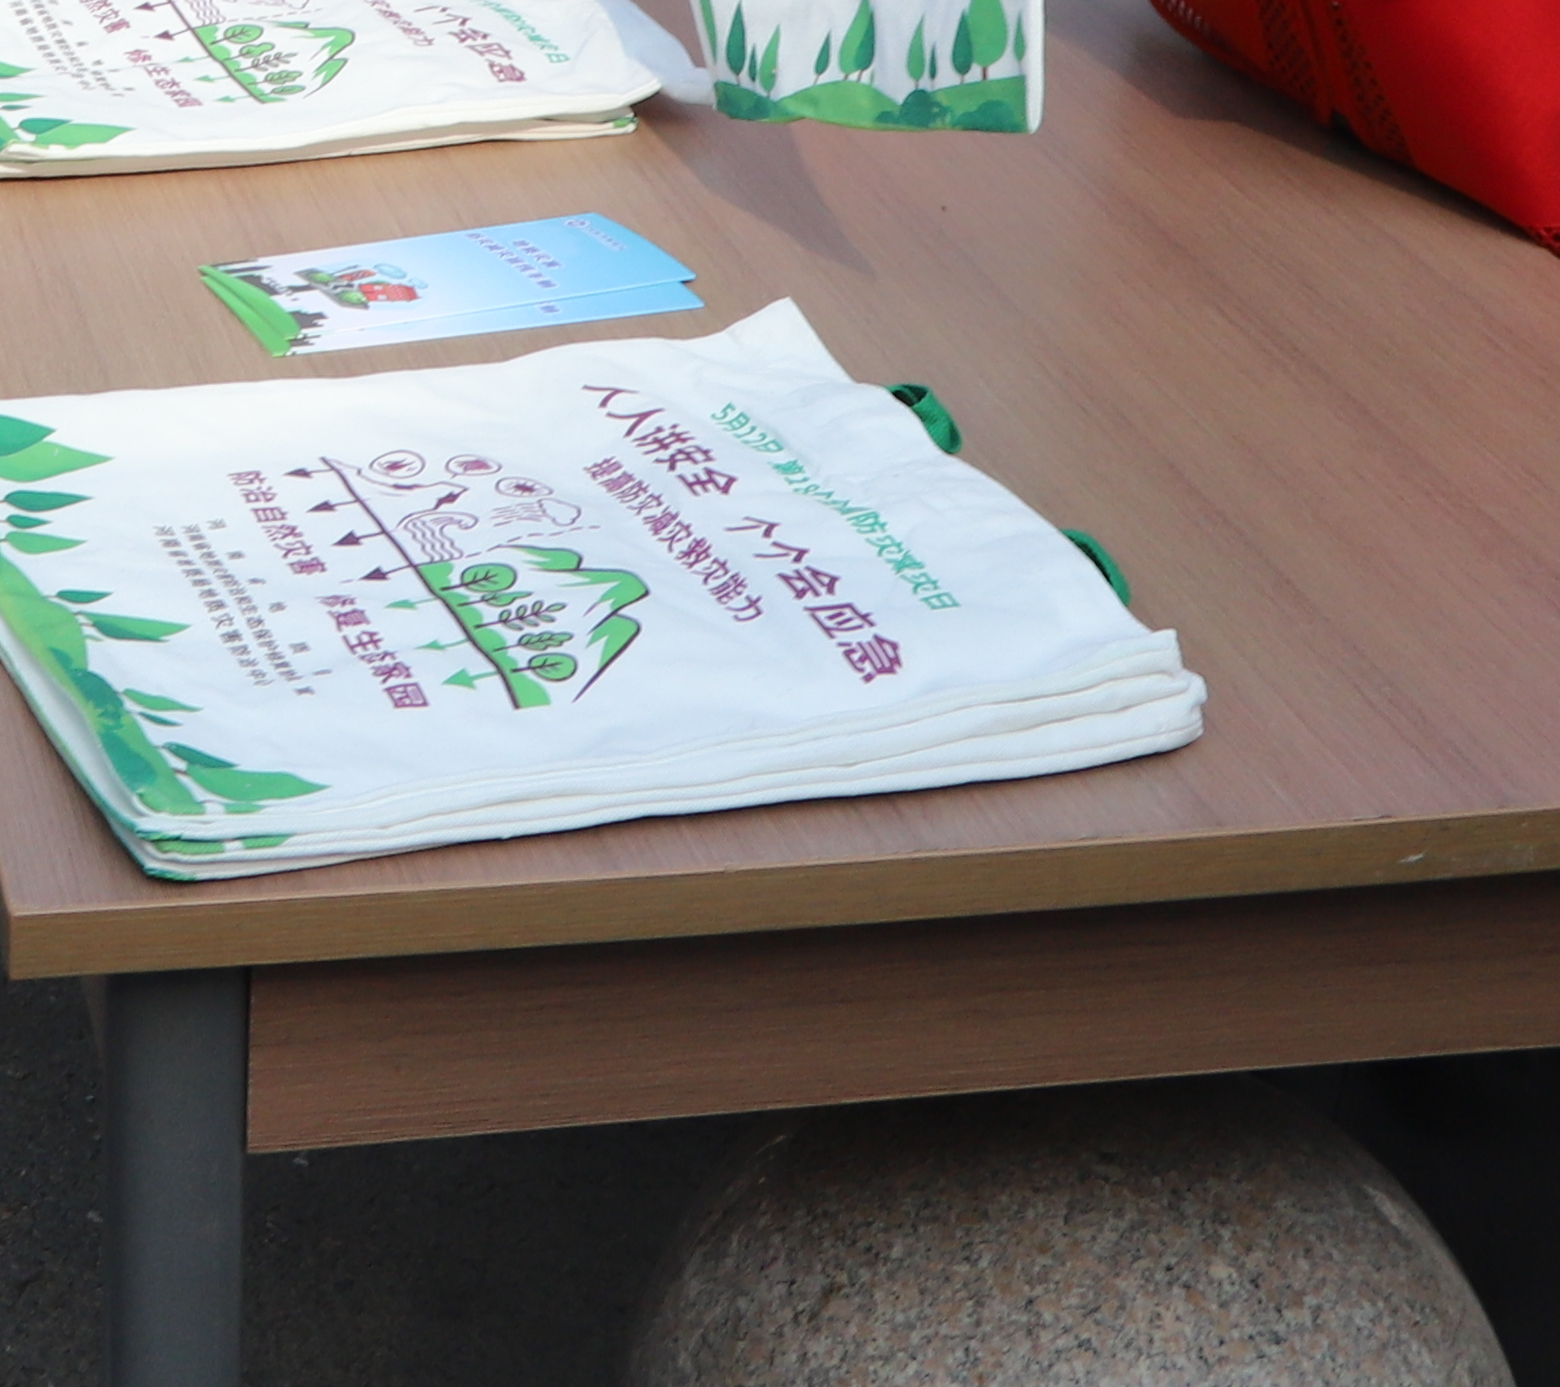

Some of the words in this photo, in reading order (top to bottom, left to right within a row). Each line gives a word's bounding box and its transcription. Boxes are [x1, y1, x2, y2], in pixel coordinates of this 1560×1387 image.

[709, 400, 785, 456] 5月12日
[227, 470, 328, 576] 防治自然灾害
[580, 383, 739, 498] 人人讲安全
[723, 515, 903, 685] 个个会应急
[581, 455, 765, 624] 提高防灾减灾救灾能力
